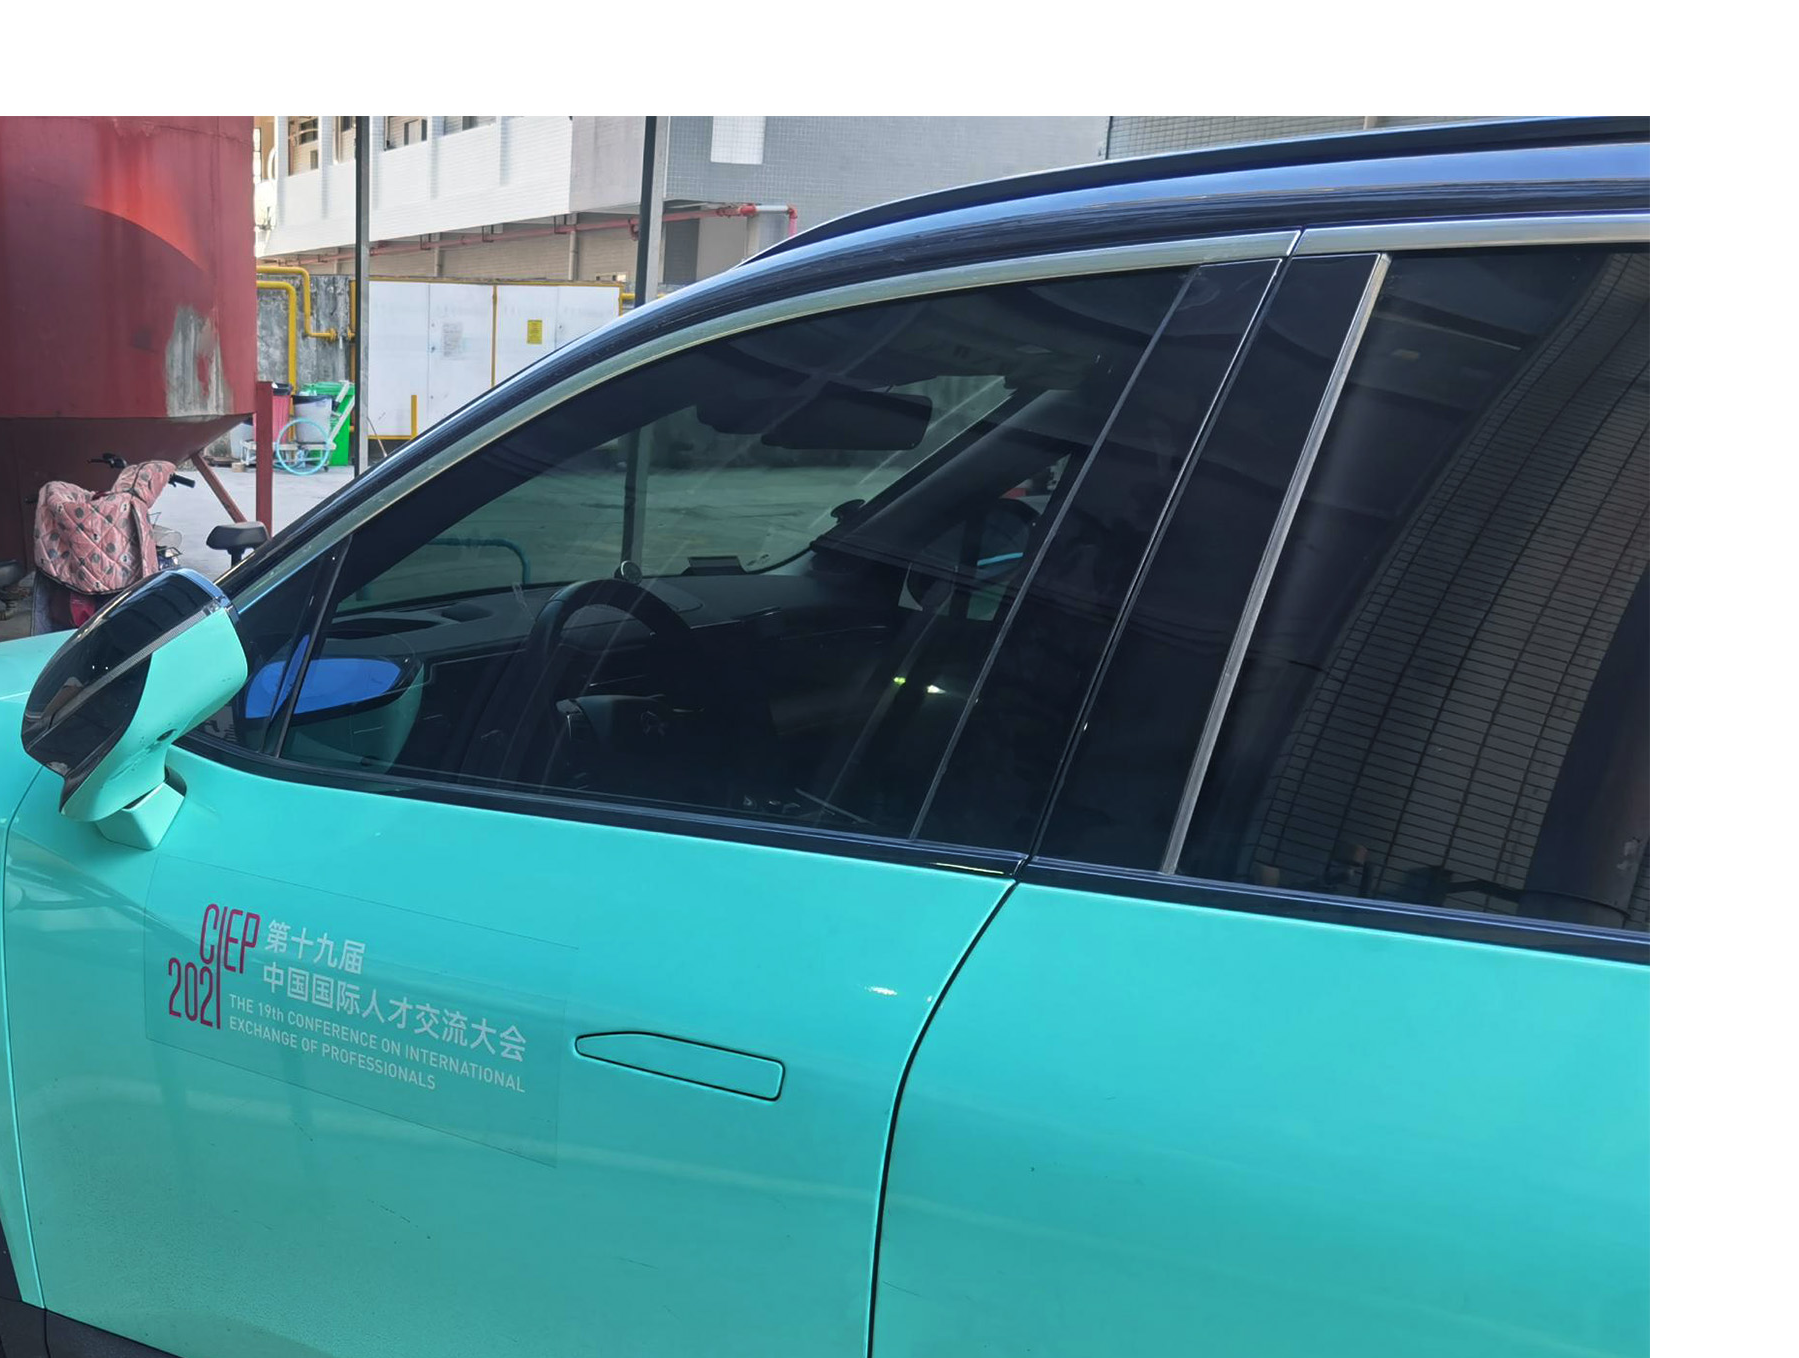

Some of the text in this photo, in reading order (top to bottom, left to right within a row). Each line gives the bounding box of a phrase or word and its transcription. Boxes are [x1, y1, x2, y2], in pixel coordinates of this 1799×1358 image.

[199, 903, 261, 975] CIEP
[265, 919, 366, 975] 第十九届
[168, 957, 221, 1030] 2021
[263, 961, 527, 1062] 中国国际人才交流大会
[229, 993, 526, 1093] THE 19th CONFERENCE ON INTERNATIONAL
[229, 1015, 437, 1090] EXCHANGE OF PROFESSIONALS
